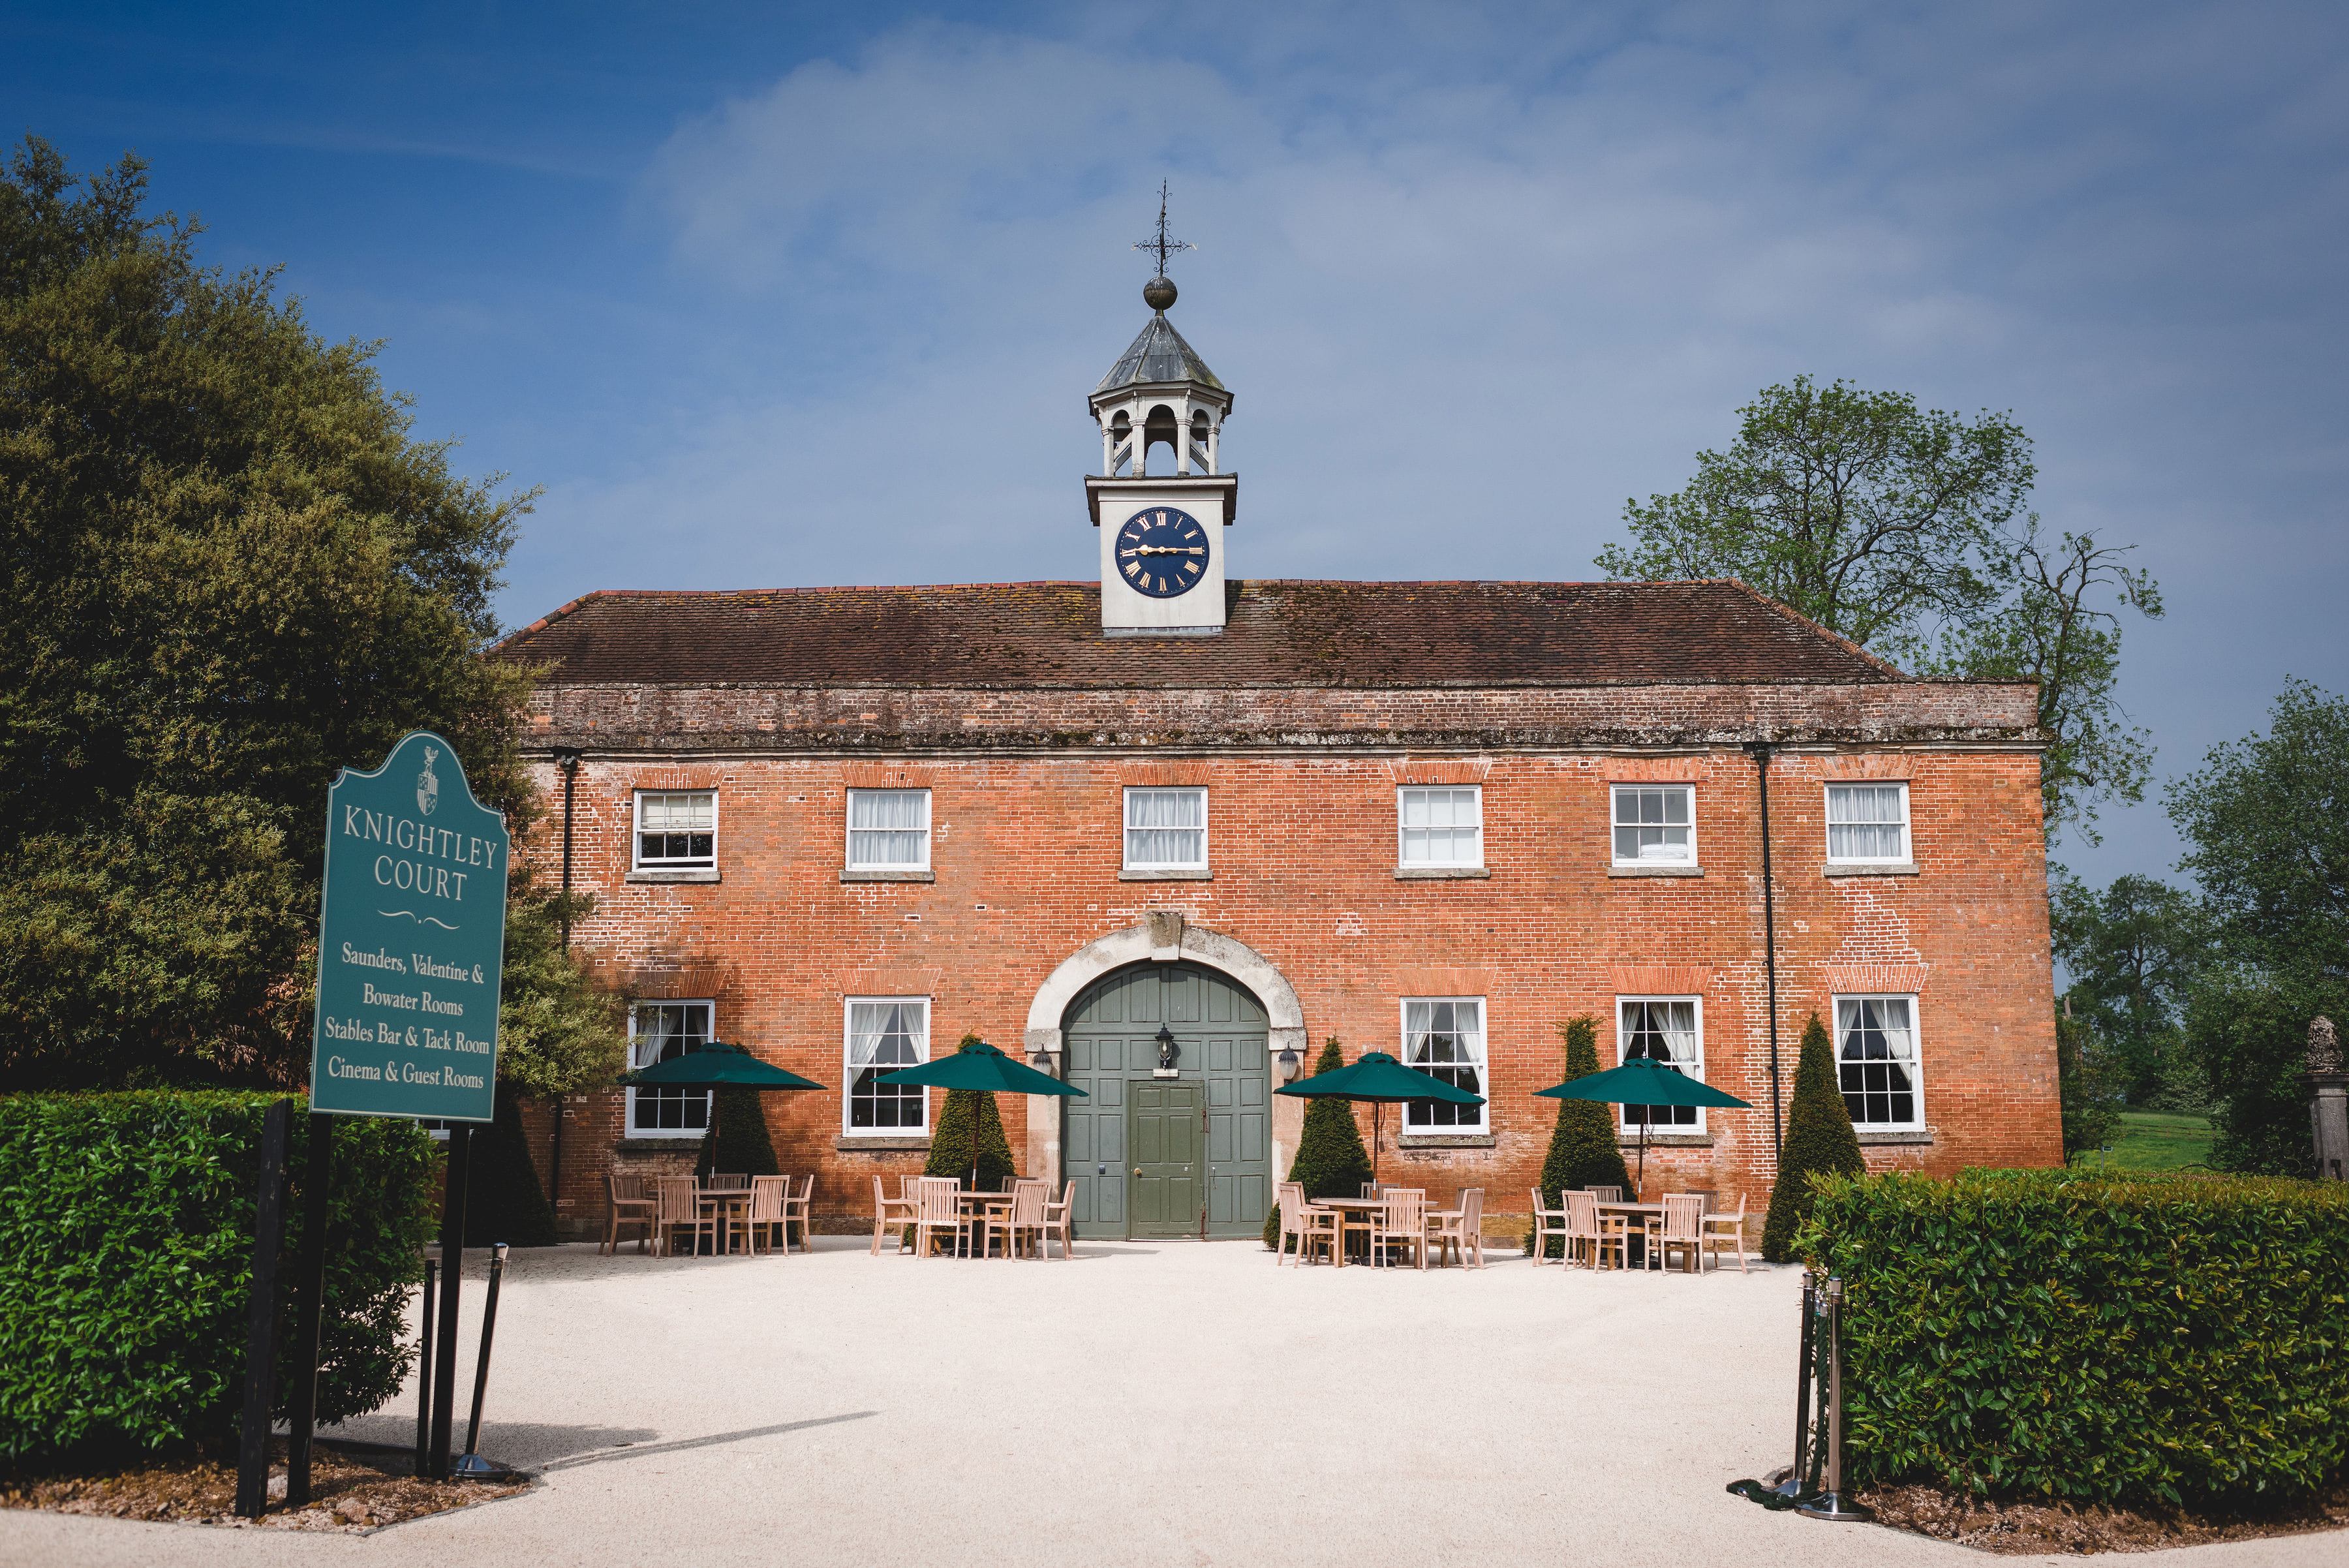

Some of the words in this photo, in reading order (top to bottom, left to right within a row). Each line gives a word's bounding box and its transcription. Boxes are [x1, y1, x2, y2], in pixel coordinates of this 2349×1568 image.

[1156, 512, 1167, 527] XII
[344, 805, 497, 869] KNIGHTLEY
[375, 855, 467, 901] COURT
[342, 942, 407, 976] Saunders,
[412, 953, 468, 982] Valentine
[472, 964, 484, 984] &
[363, 983, 418, 1011] Bowater
[422, 991, 464, 1017] Rooms
[326, 1016, 374, 1042] Stables
[378, 1022, 401, 1045] Bar
[405, 1026, 419, 1047] &
[423, 1028, 452, 1050] Tack
[455, 1032, 490, 1054] Room
[328, 1056, 381, 1081] Cinema
[385, 1060, 399, 1082] &
[403, 1062, 440, 1085] Guest
[444, 1066, 484, 1089] Rooms
